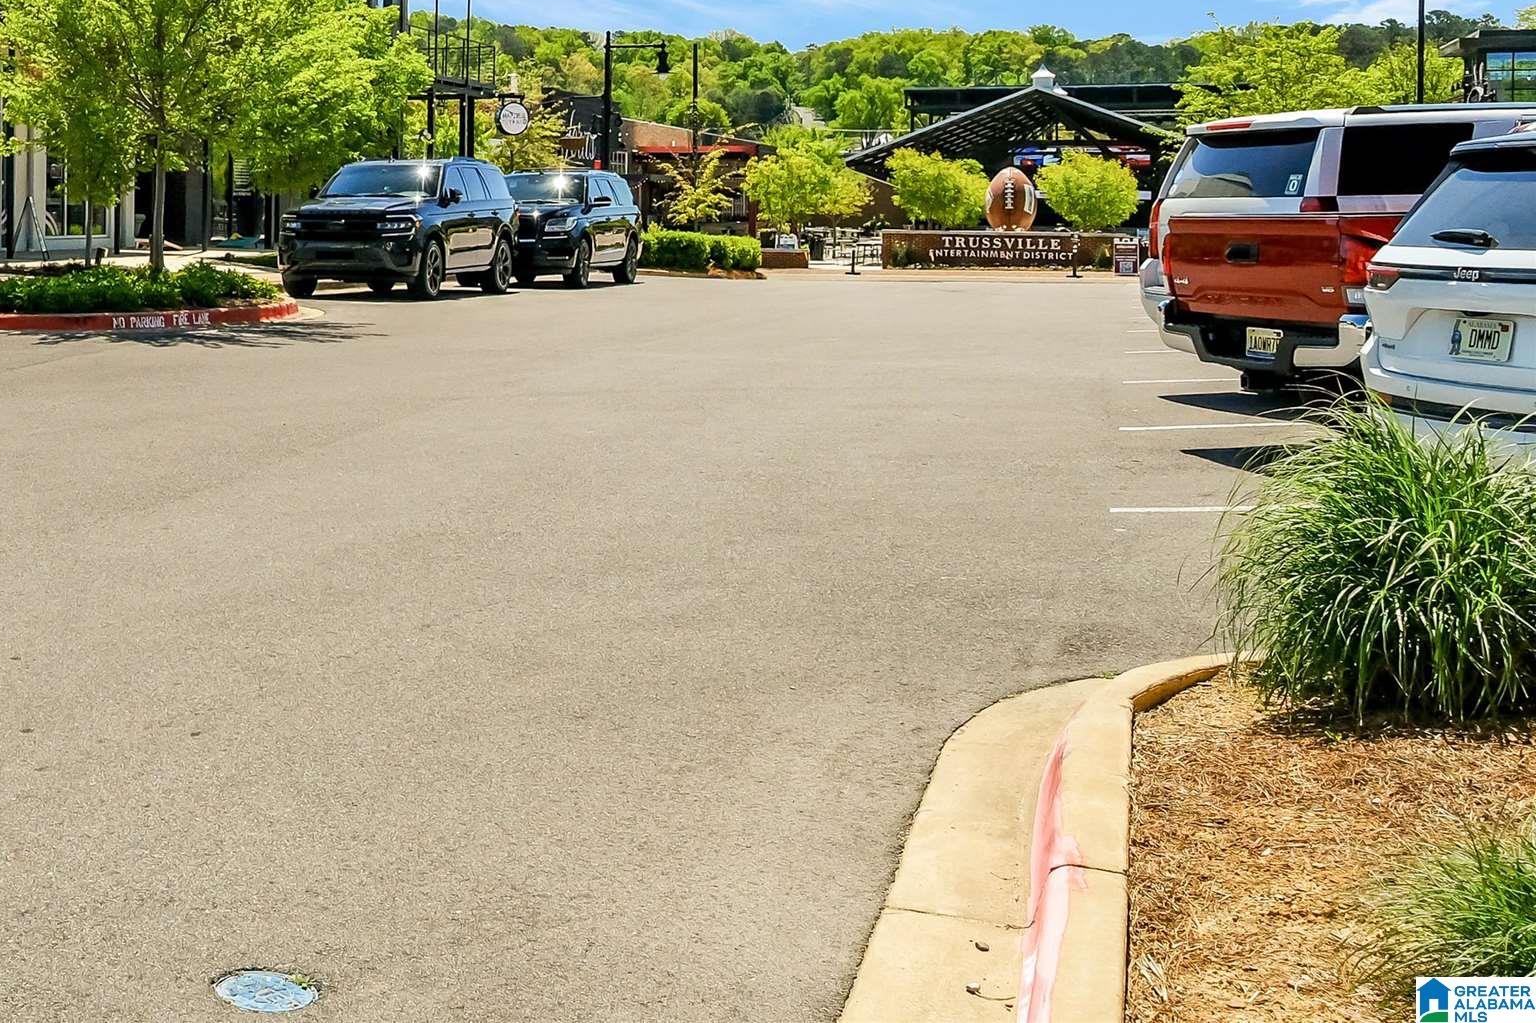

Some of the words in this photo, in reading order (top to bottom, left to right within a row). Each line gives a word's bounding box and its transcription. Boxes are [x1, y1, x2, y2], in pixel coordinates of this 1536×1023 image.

[942, 237, 1061, 250] TRUSSVILLE
[929, 249, 1021, 260] ENTERTAINMENT
[1023, 251, 1073, 261] DISTRICT
[1453, 267, 1479, 281] Jeep
[112, 317, 125, 328] NO
[130, 316, 165, 328] PARKING
[173, 313, 190, 325] FIRE
[192, 312, 211, 325] LANE
[1469, 328, 1500, 350] DMMD
